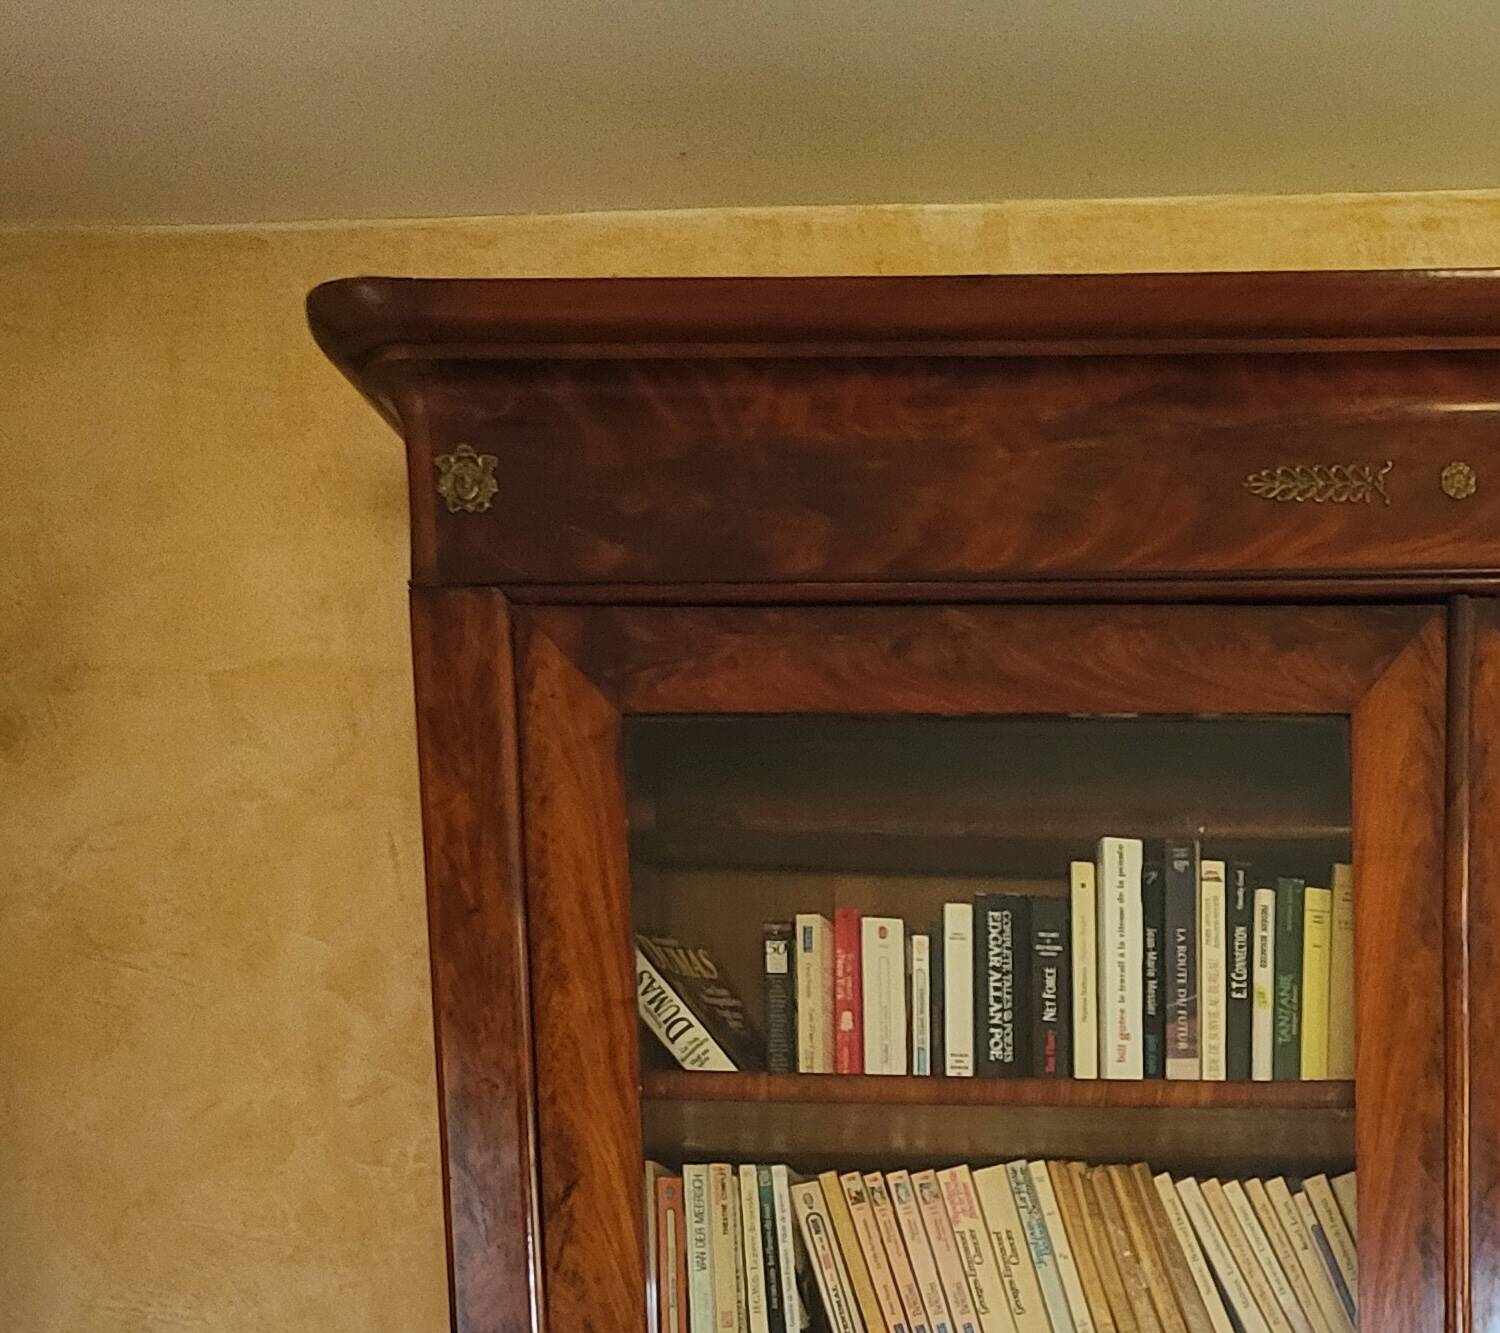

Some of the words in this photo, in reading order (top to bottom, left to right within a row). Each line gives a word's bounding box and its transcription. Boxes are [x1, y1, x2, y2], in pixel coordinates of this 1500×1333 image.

[987, 911, 1004, 968] EDGAR
[1175, 928, 1188, 942] LA
[1175, 945, 1188, 985] ROUTE
[638, 970, 695, 1044] DUMAS
[987, 970, 1004, 1025] ALLAN
[1175, 989, 1188, 1006] DU
[987, 1028, 1004, 1061] POE
[1175, 1009, 1189, 1050] FUTUR
